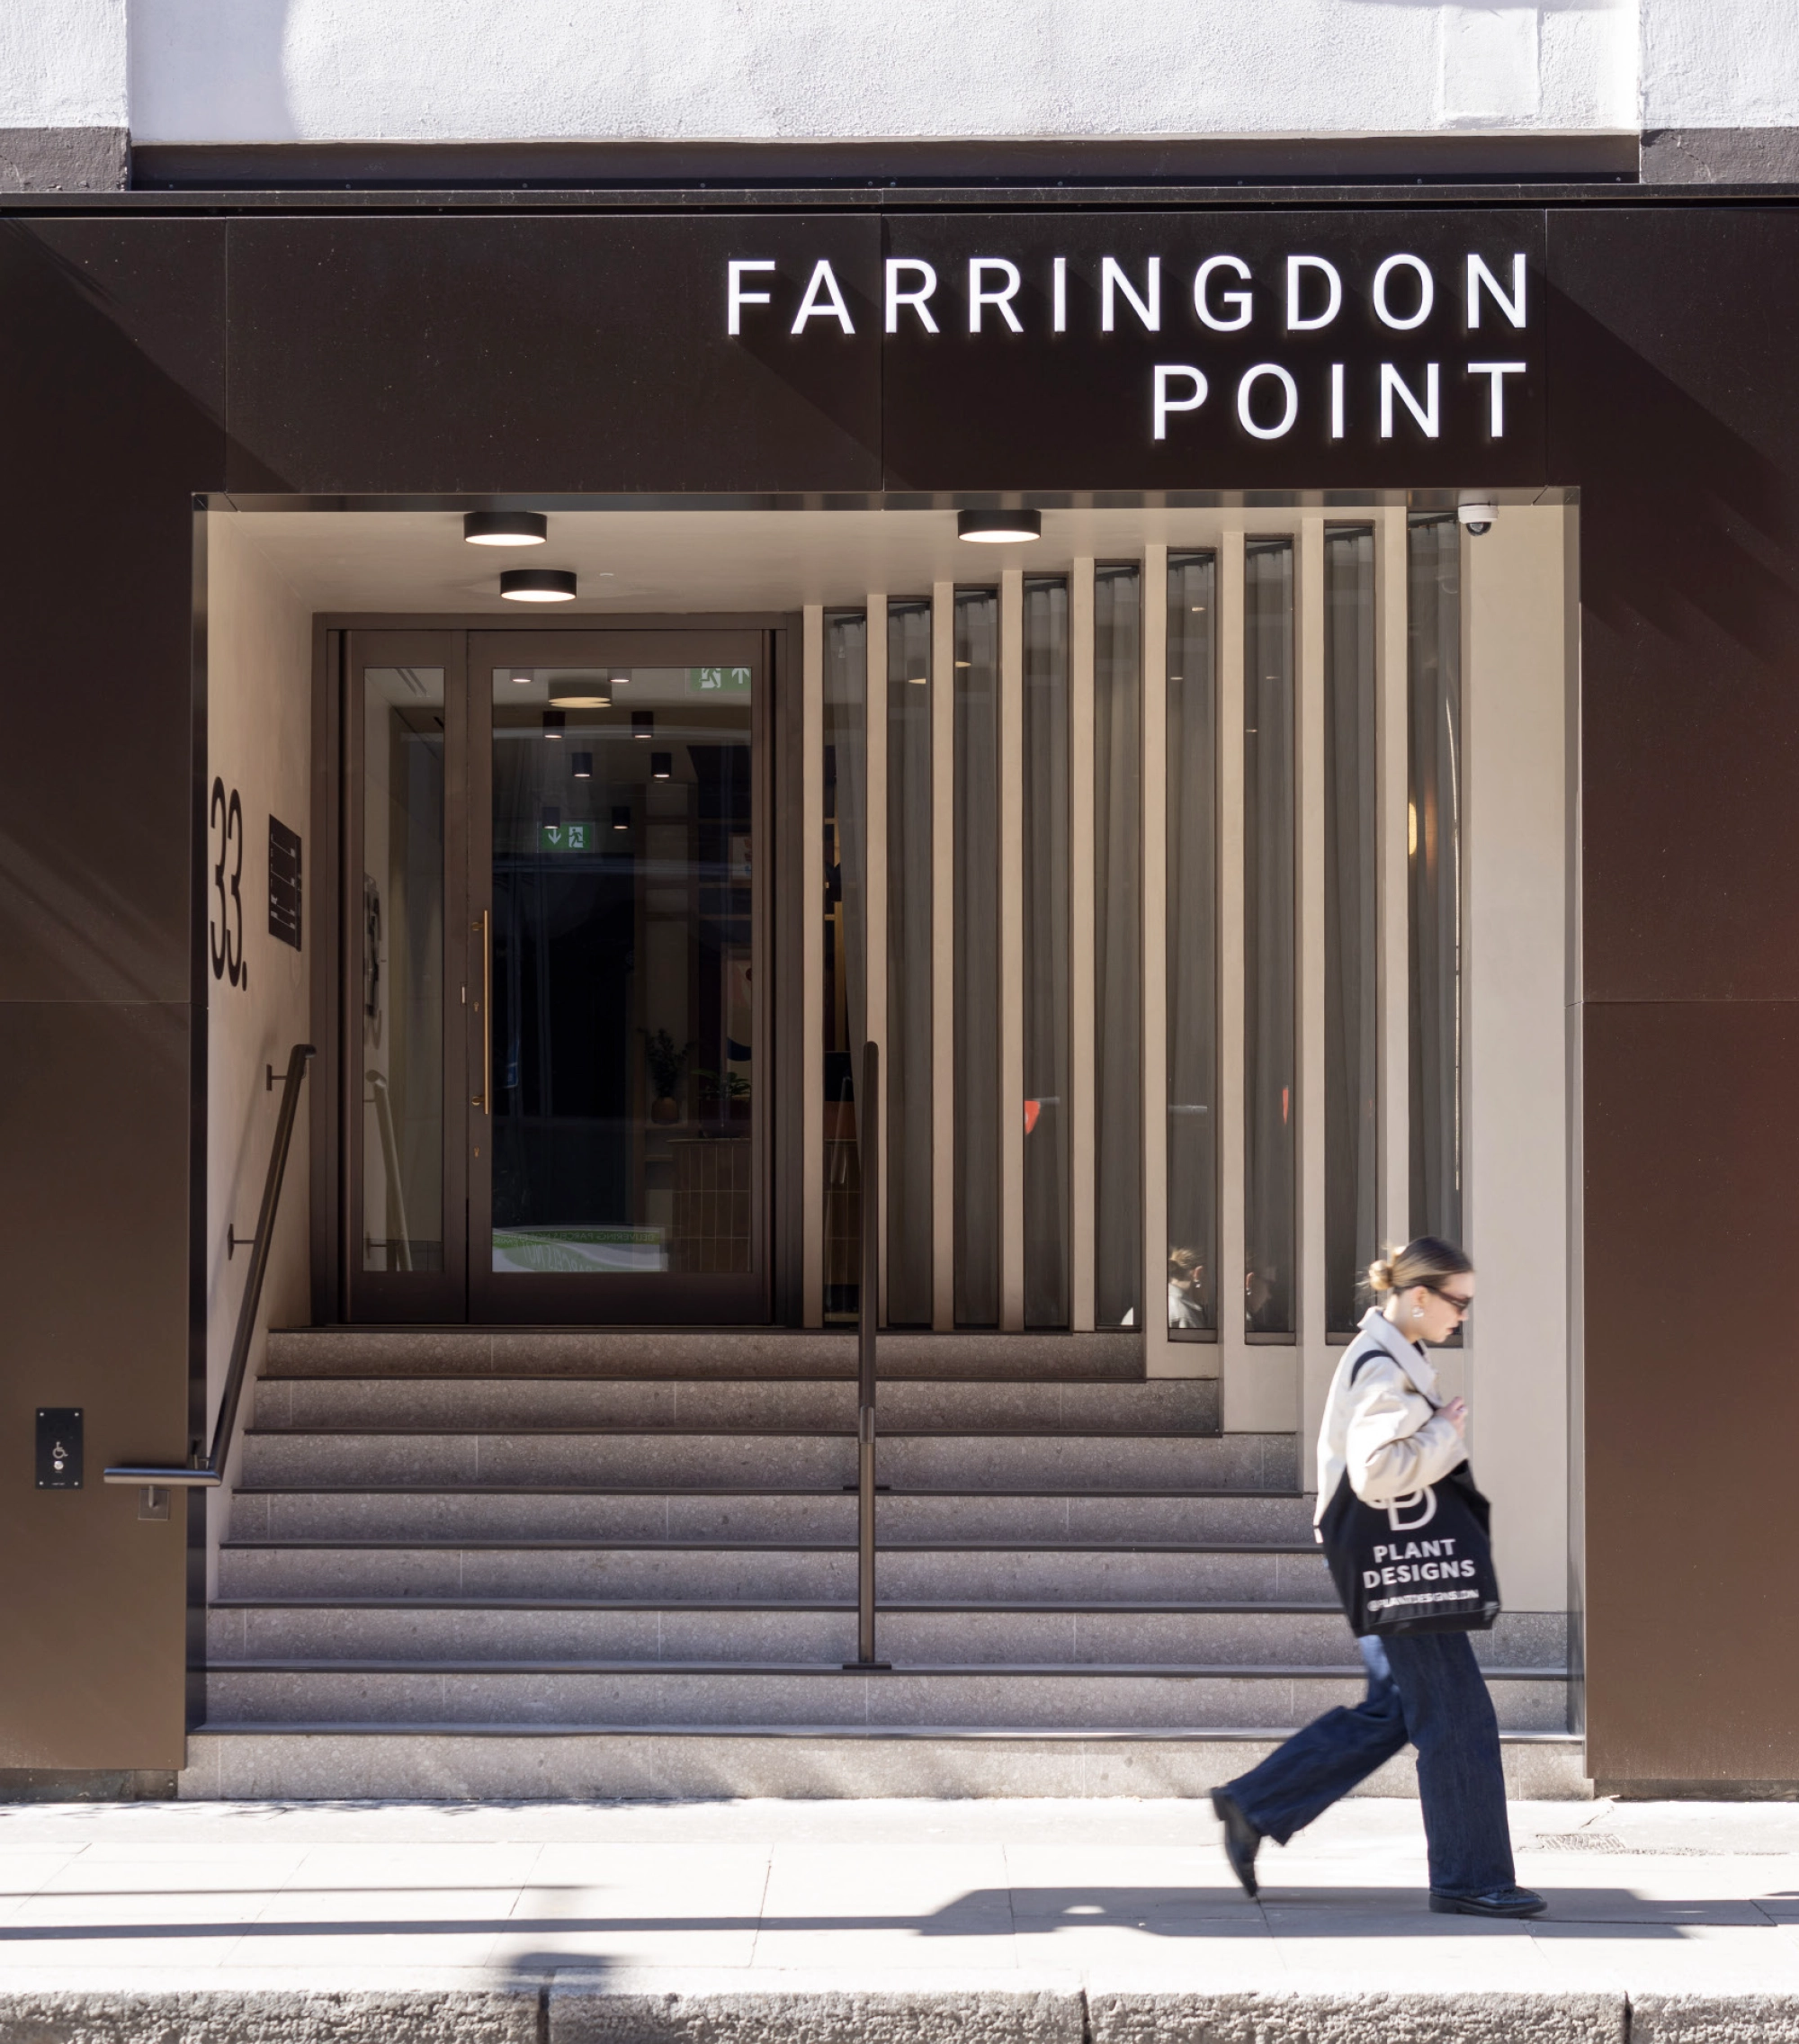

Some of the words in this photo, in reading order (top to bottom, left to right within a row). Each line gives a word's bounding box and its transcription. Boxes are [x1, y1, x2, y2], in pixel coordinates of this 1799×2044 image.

[726, 253, 1527, 336] FARRINGDON
[1153, 362, 1527, 441] POINT
[1362, 1559, 1476, 1589] DESIGNS
[1373, 1538, 1456, 1564] PLANT
